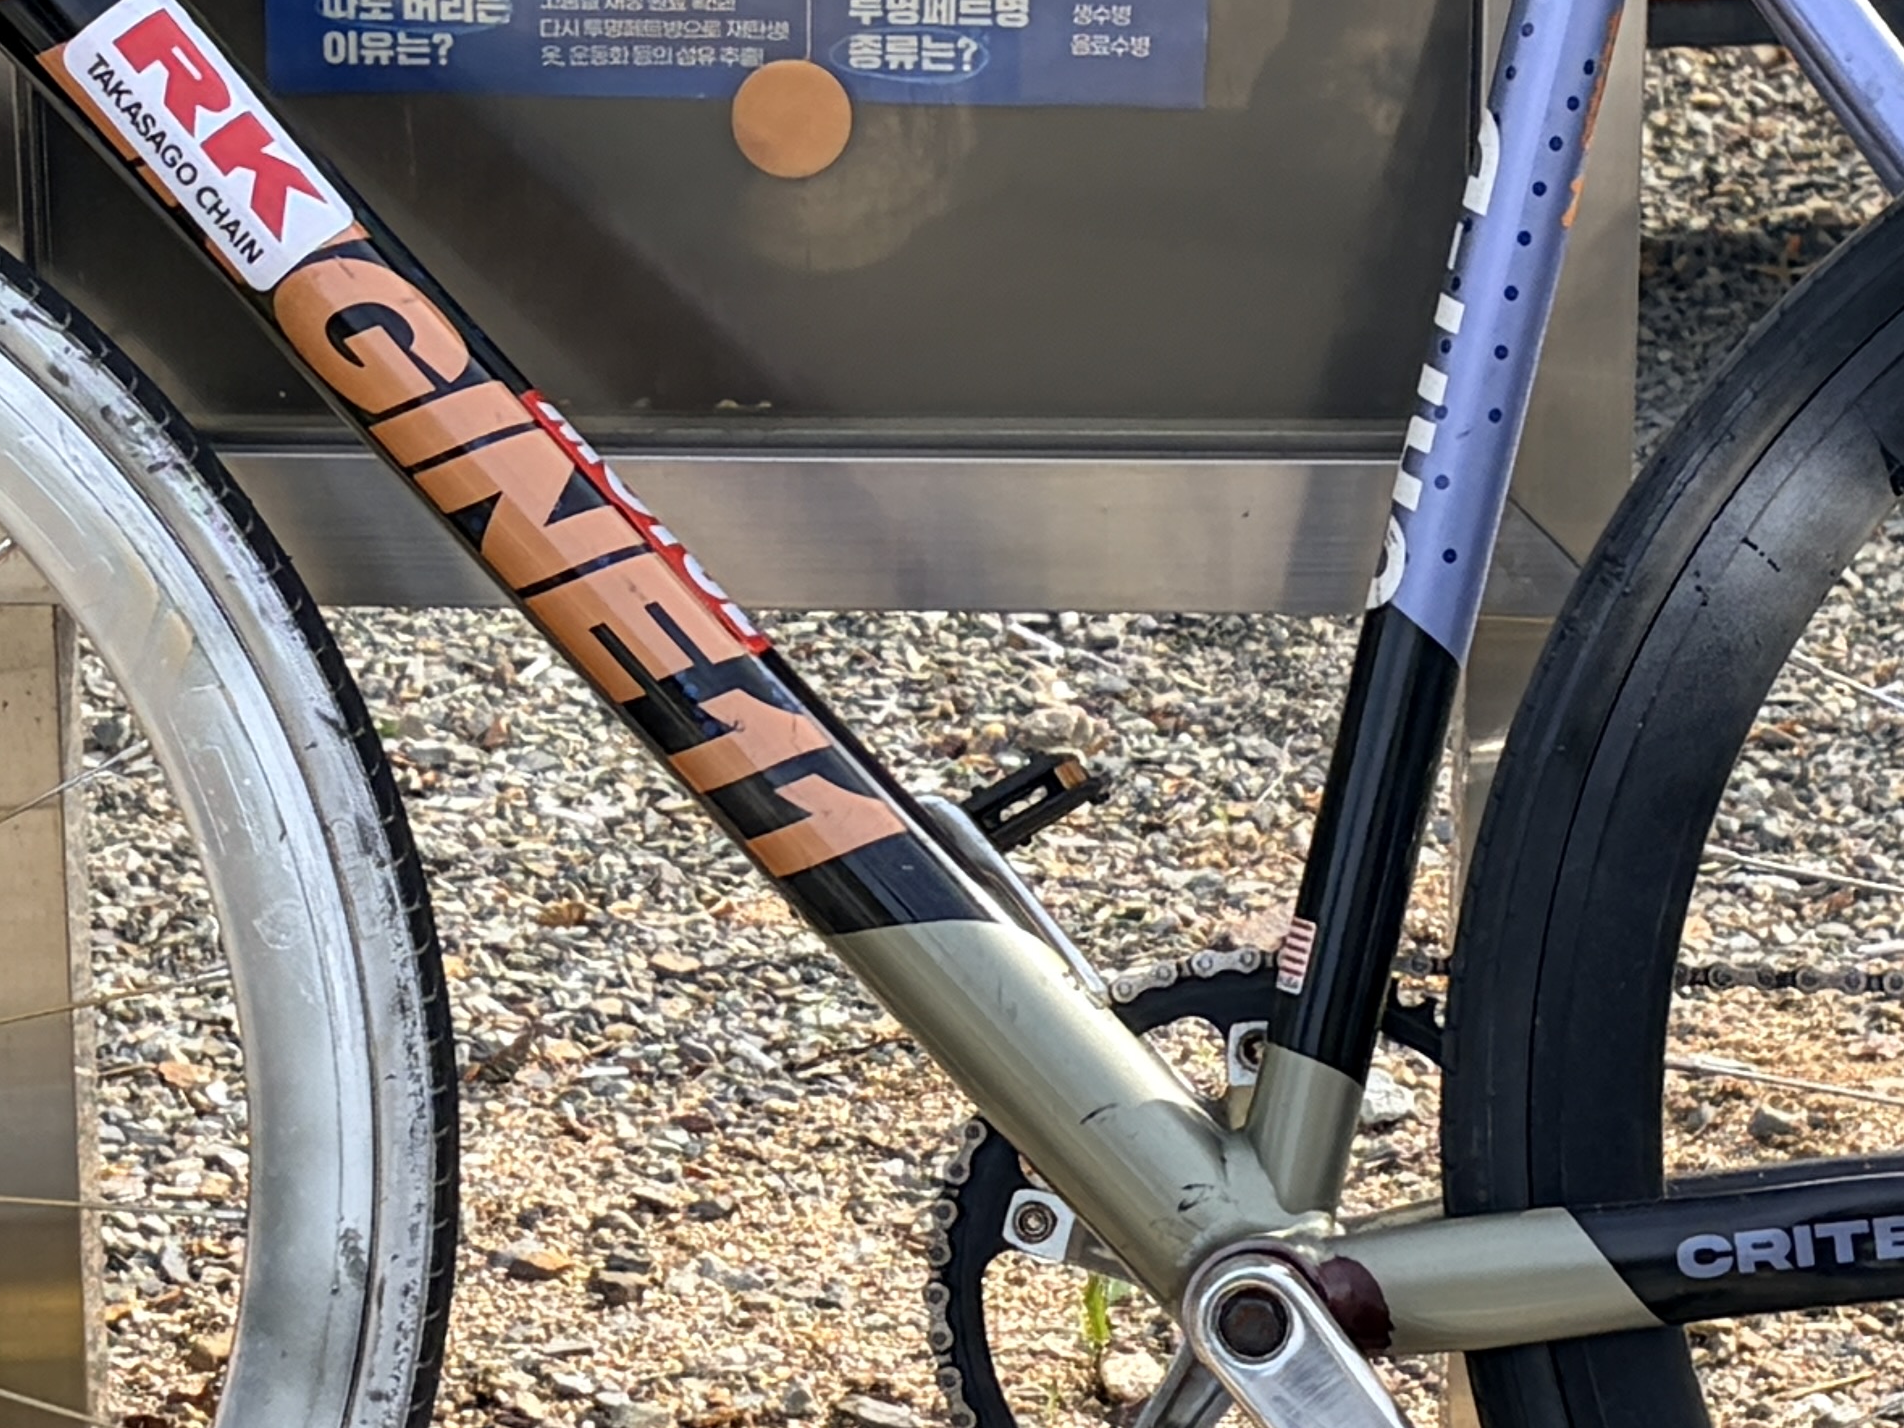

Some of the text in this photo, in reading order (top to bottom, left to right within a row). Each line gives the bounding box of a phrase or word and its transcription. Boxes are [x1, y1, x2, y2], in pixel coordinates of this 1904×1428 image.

[539, 19, 580, 38] 다시
[322, 31, 454, 66] 이유는?
[848, 34, 978, 72] 종류는?
[113, 8, 327, 243] RK
[86, 53, 264, 266] TAKASAGO CHAIN
